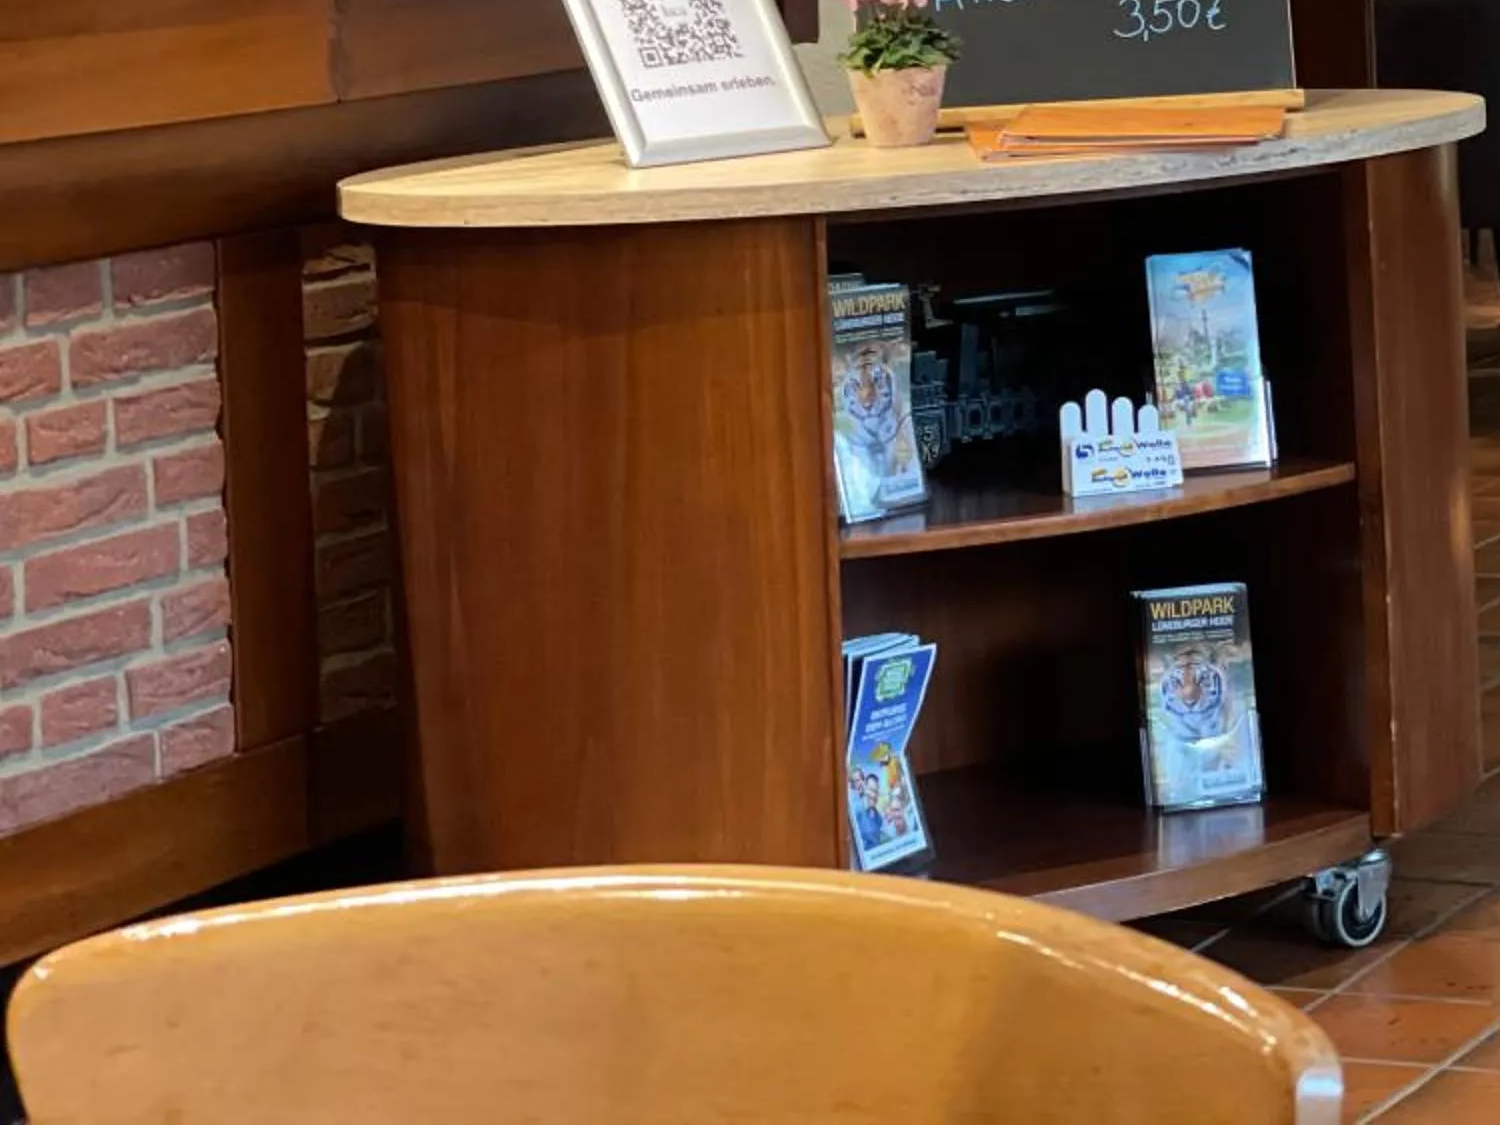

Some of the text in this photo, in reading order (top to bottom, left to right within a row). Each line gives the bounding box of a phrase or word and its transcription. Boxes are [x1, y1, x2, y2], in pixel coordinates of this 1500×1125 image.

[631, 81, 718, 103] Gemeinsam
[832, 292, 907, 318] WILDPARK
[1149, 595, 1235, 620] WILDPARK
